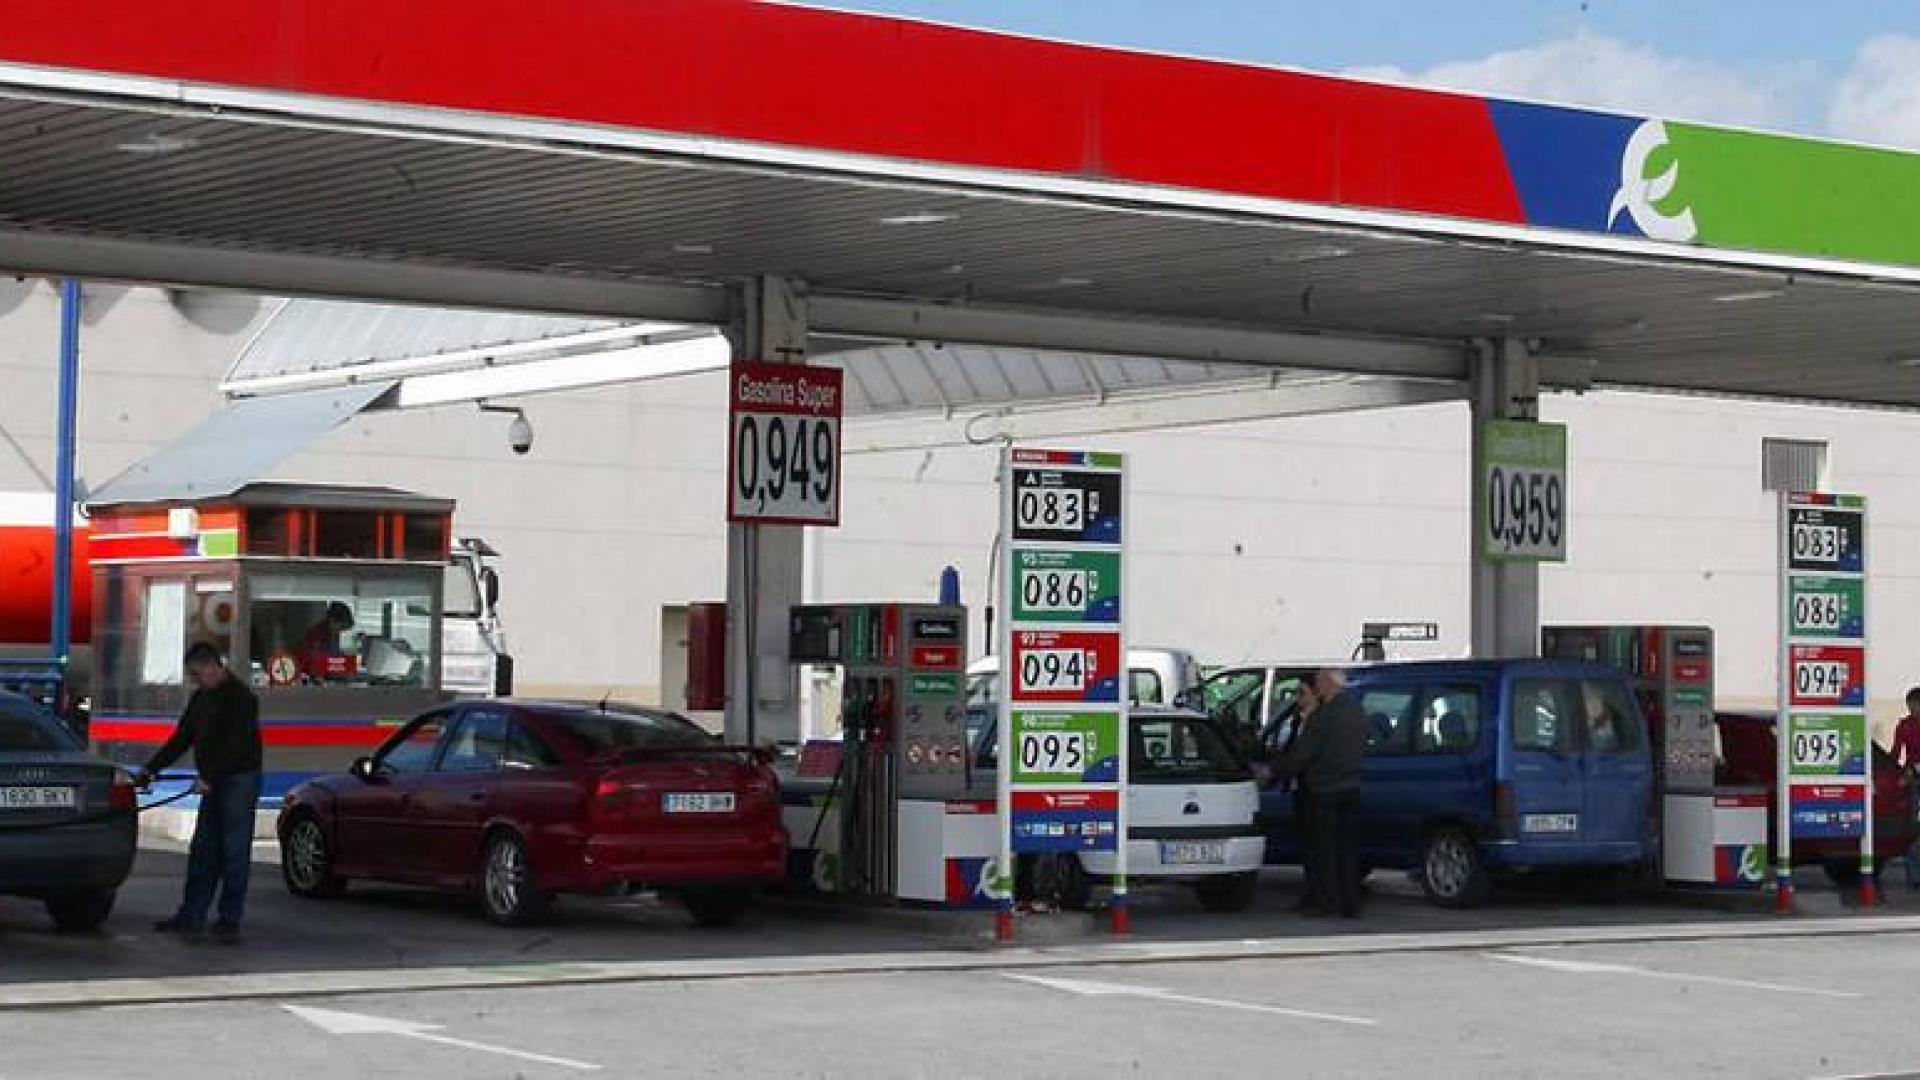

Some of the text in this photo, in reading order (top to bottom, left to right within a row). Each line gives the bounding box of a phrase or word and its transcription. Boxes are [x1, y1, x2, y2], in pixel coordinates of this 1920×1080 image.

[798, 376, 836, 414] Super
[738, 416, 832, 514] 0,949
[1022, 491, 1079, 525] 083
[1489, 467, 1562, 551] 0,959
[1024, 573, 1082, 607] 086
[1796, 596, 1837, 624] 086
[1024, 652, 1082, 686] 094
[1798, 664, 1840, 694] 094
[1022, 735, 1080, 768] 095
[1795, 734, 1837, 762] 095
